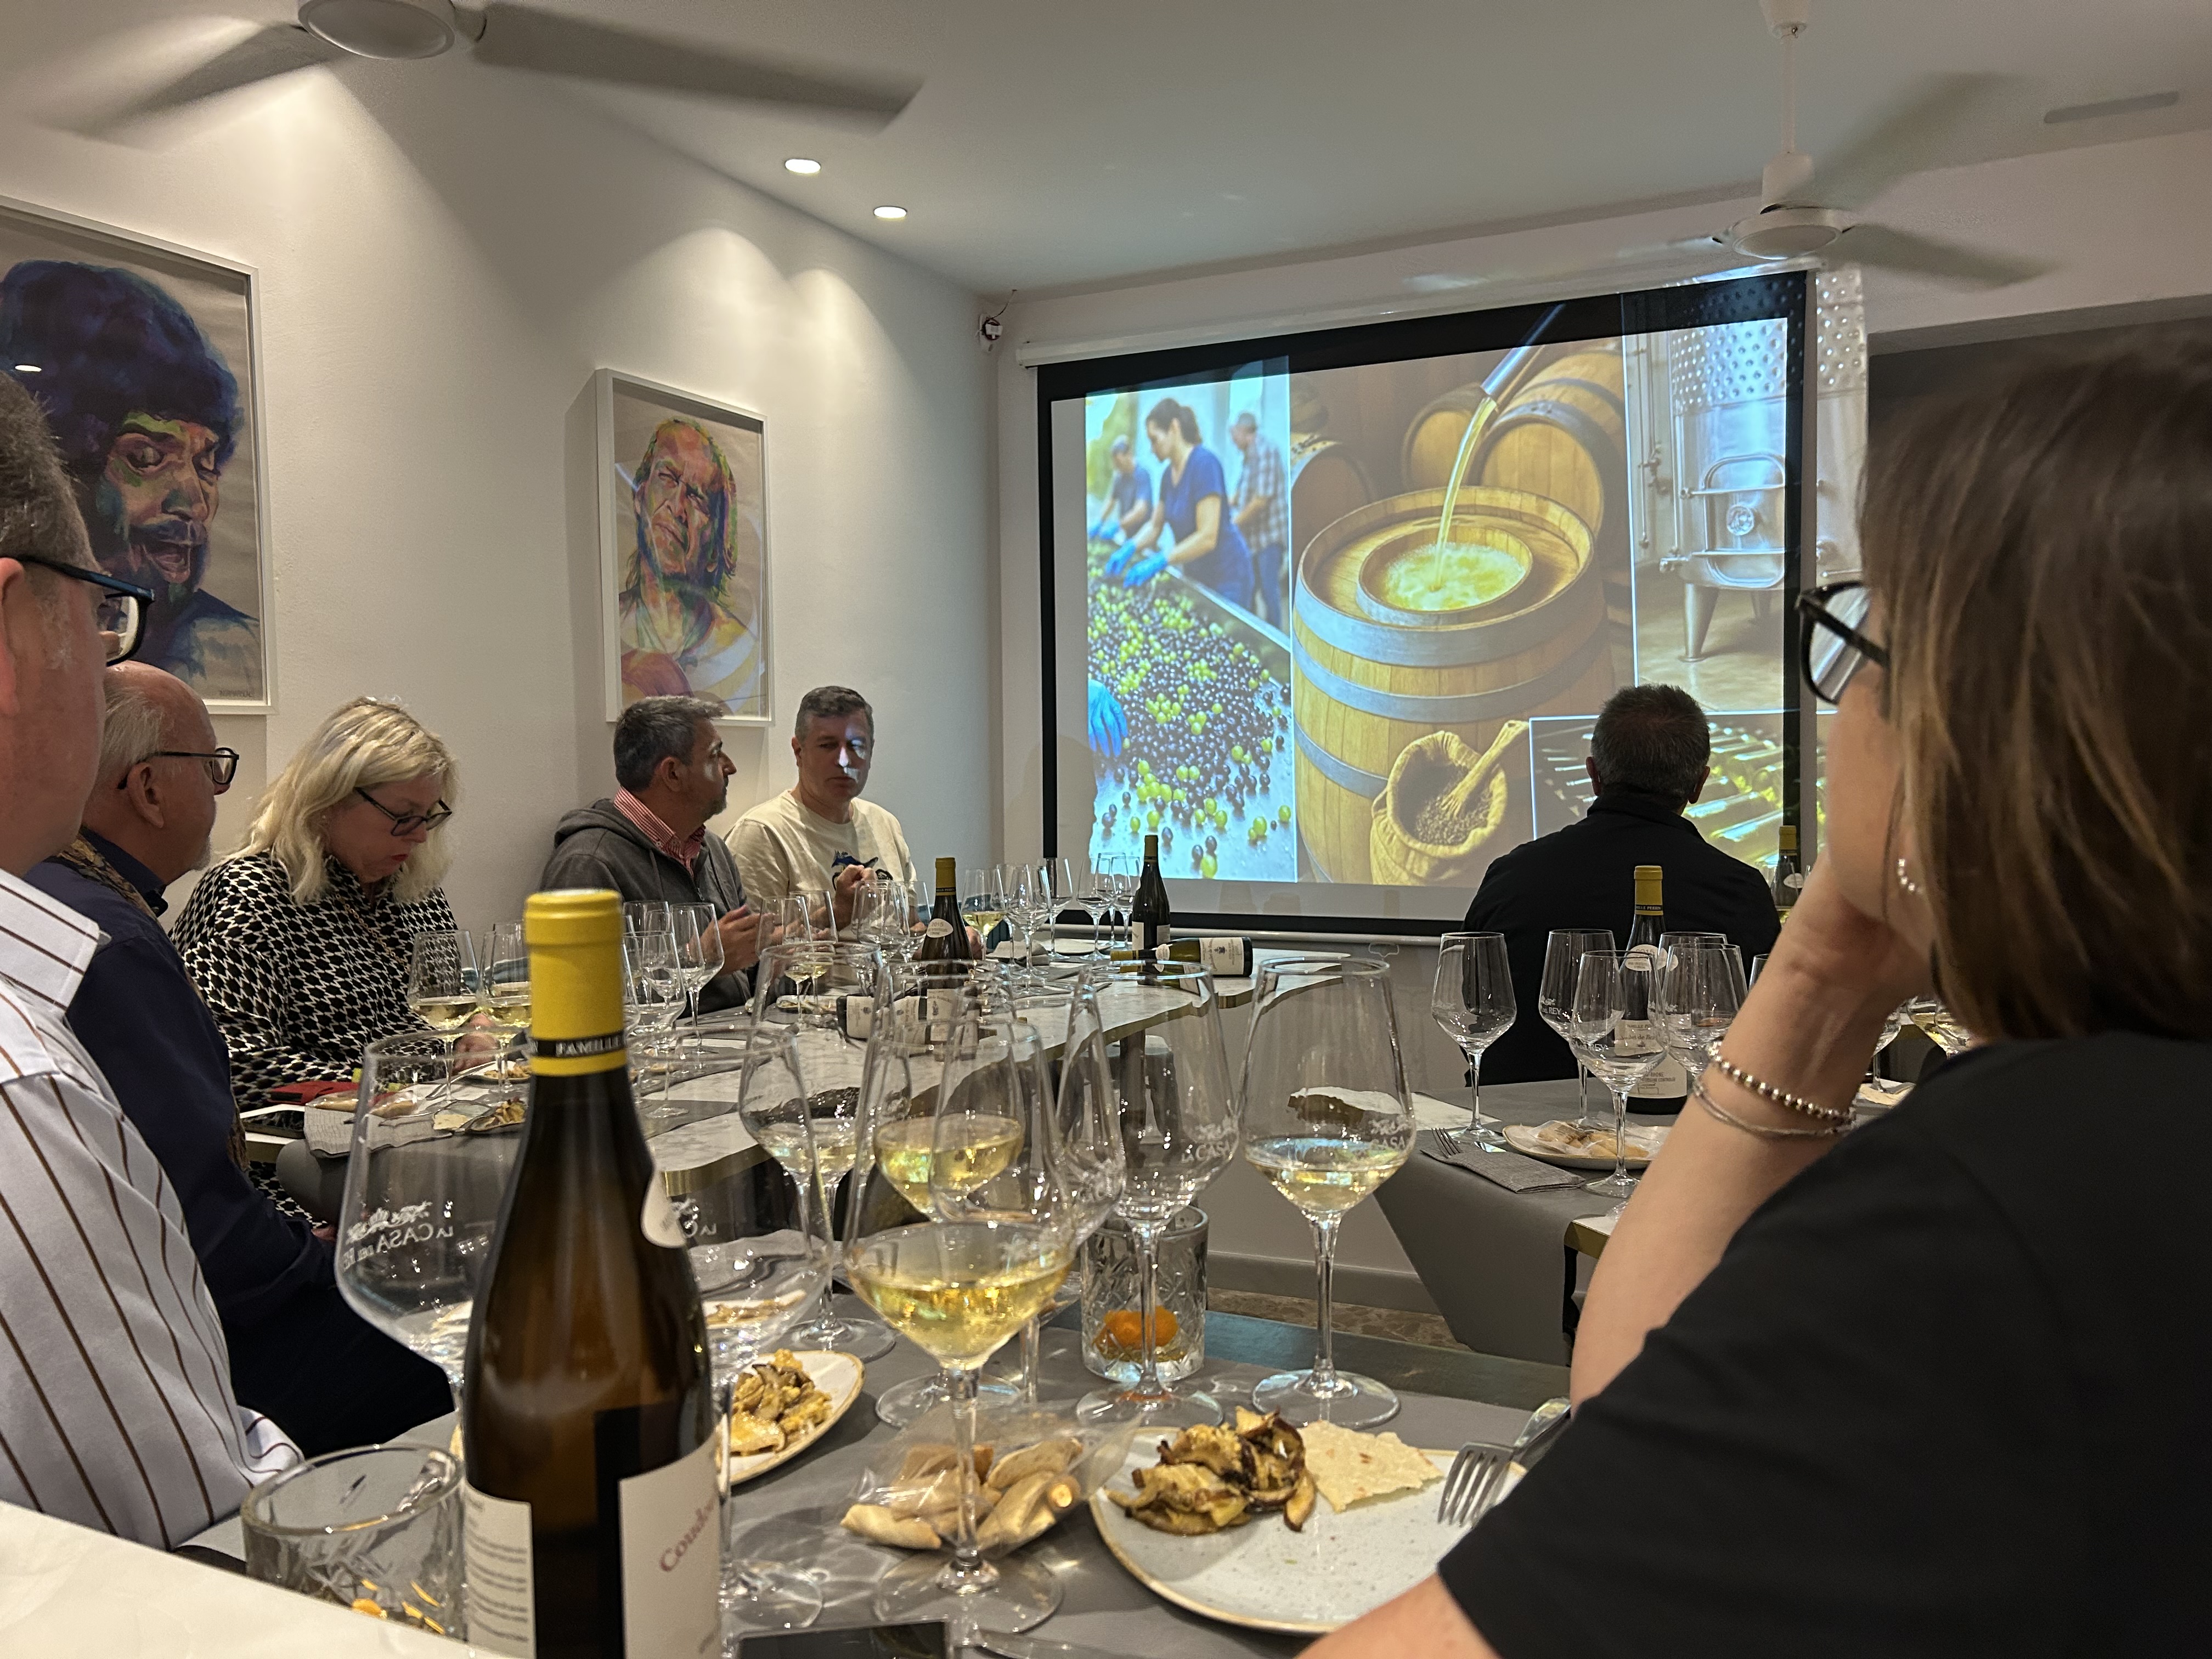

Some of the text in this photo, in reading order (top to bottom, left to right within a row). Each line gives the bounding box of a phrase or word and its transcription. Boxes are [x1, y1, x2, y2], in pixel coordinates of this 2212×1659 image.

[1548, 1007, 1562, 1015] REY
[1369, 1136, 1406, 1152] CASA
[1181, 1152, 1195, 1164] LA
